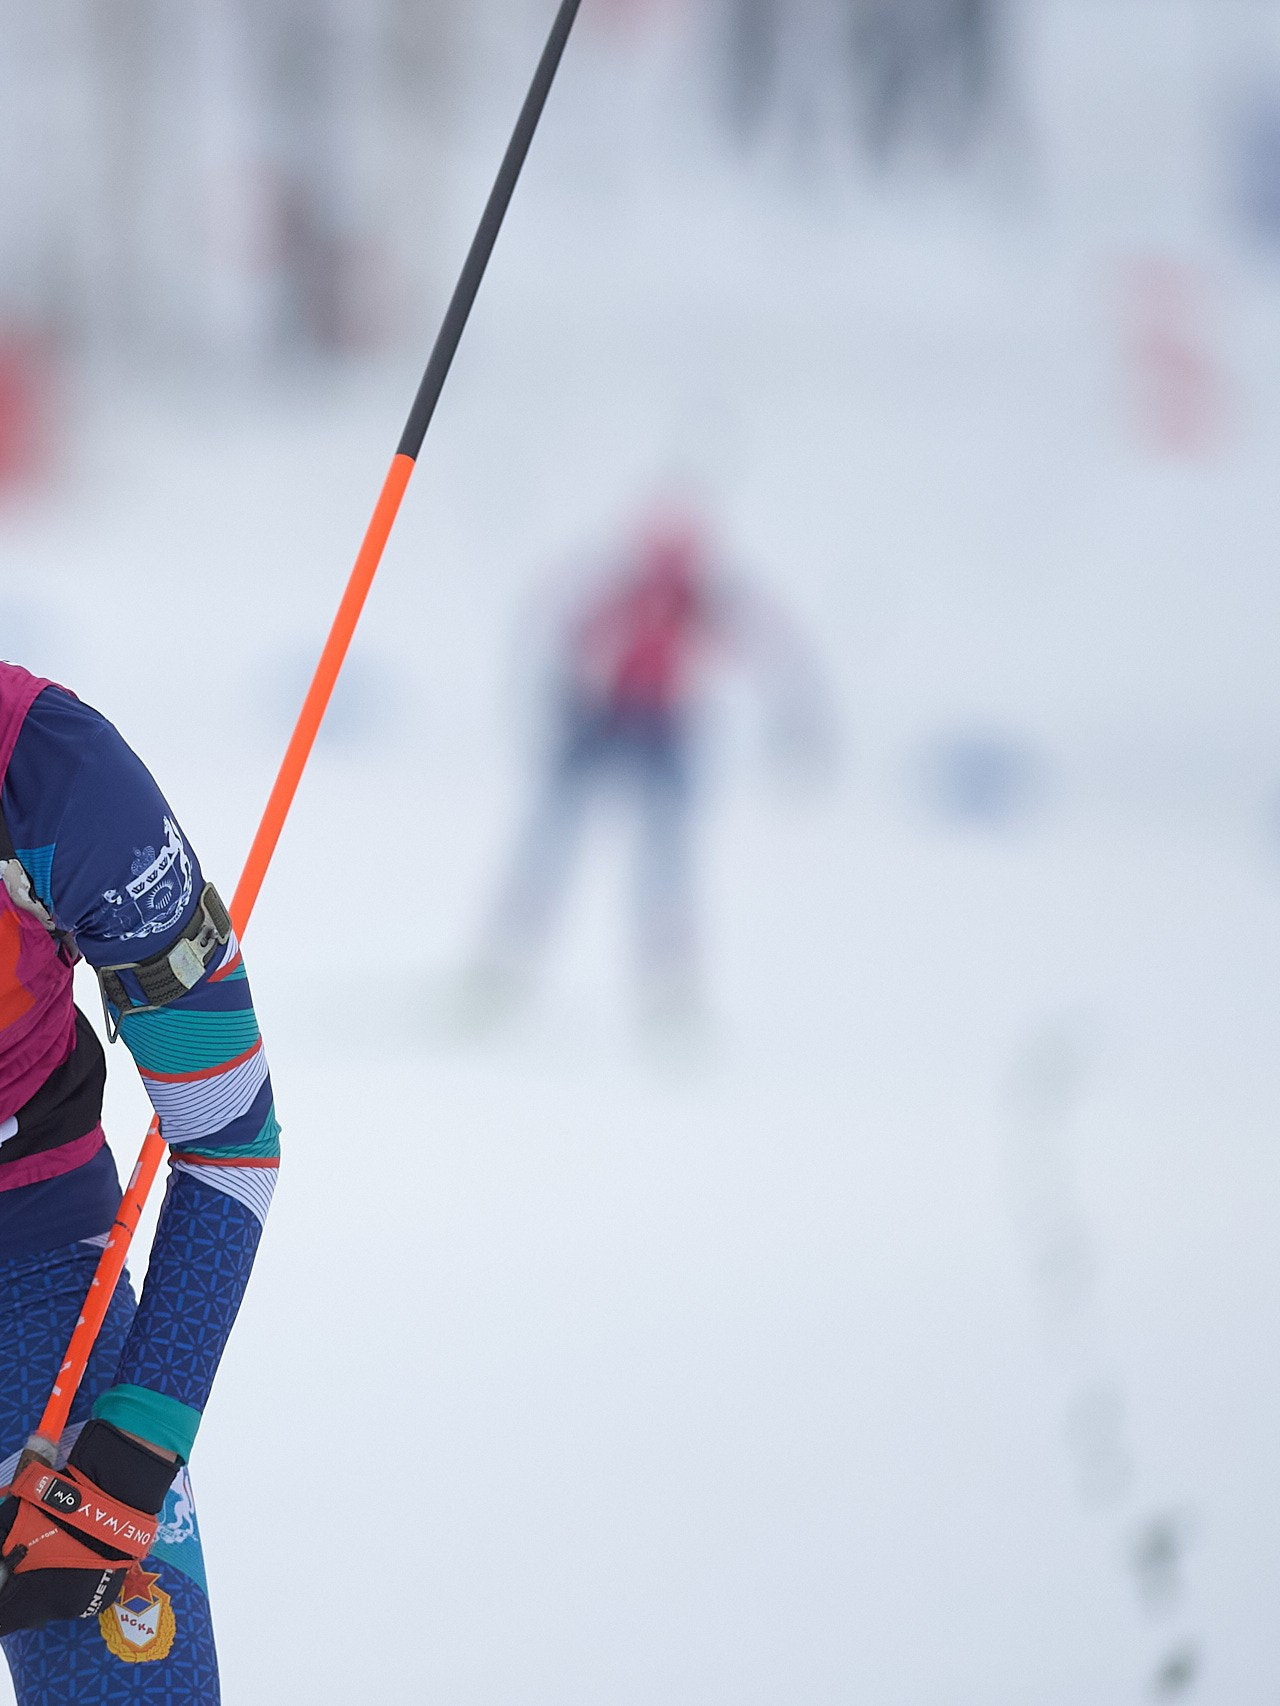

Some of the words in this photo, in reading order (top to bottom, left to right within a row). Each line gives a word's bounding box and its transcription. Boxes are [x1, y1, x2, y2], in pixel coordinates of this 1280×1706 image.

[36, 1475, 49, 1494] LEFT
[80, 1568, 113, 1618] KINETI
[120, 1614, 154, 1635] ЦСКА
